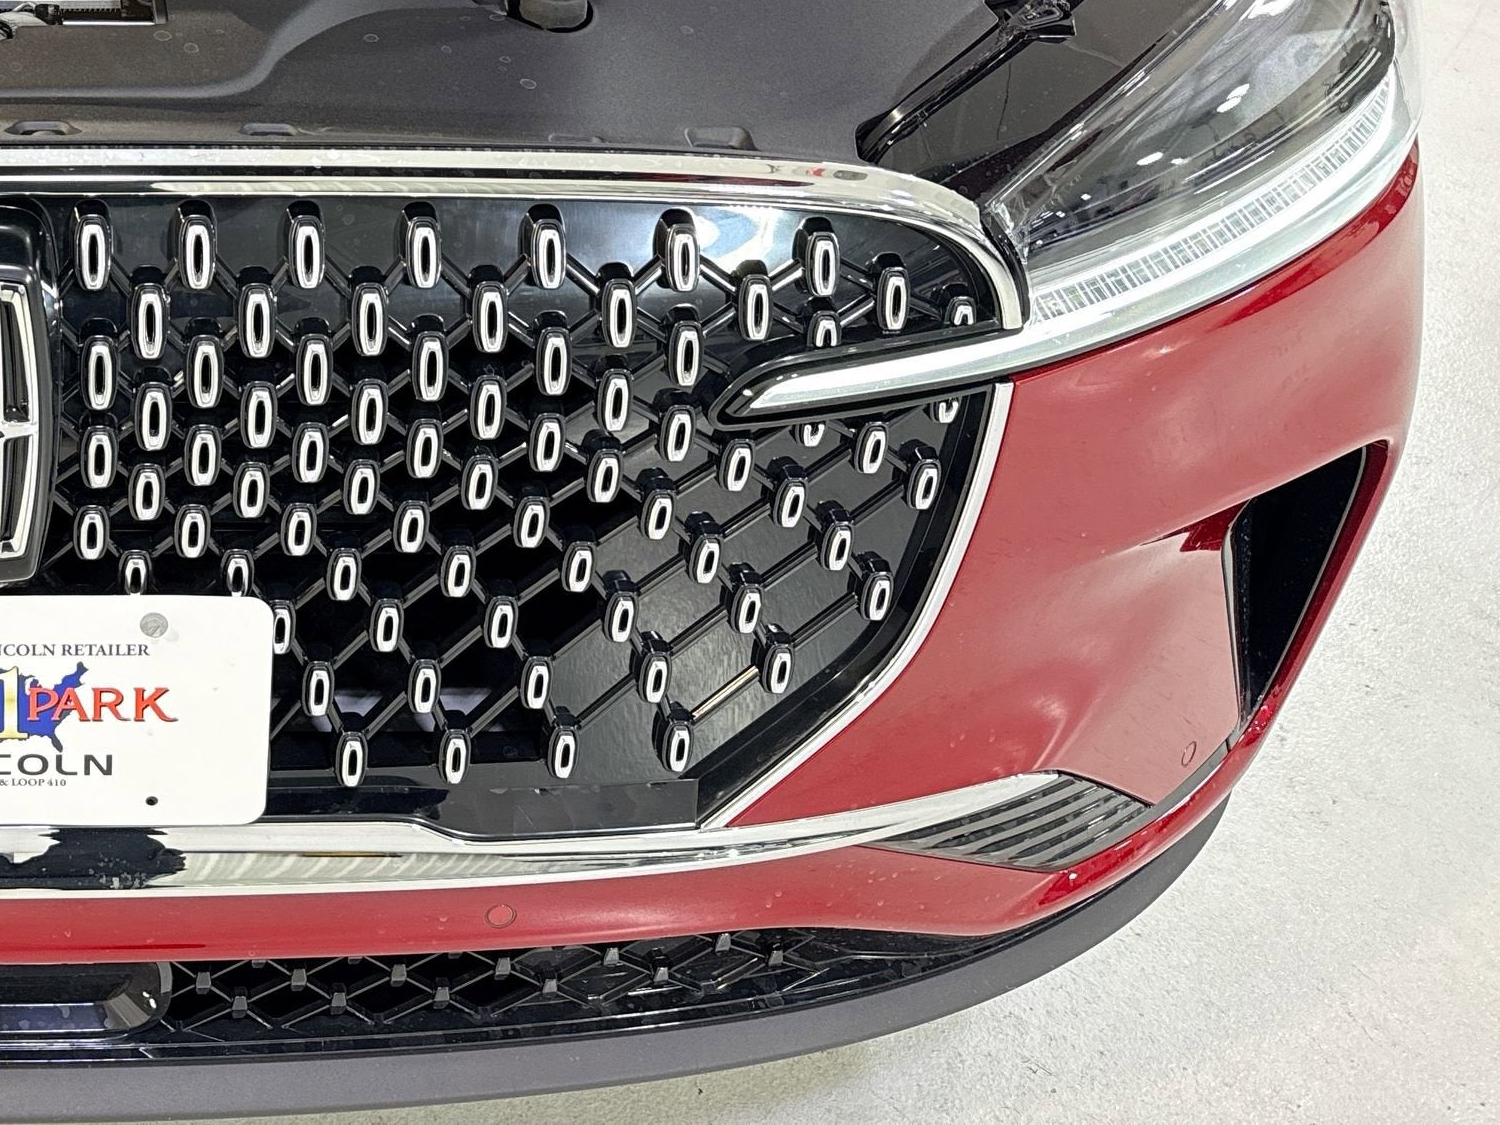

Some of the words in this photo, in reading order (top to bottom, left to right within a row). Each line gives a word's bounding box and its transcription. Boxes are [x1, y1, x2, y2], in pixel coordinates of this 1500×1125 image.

[60, 643, 150, 657] RETAILER
[27, 686, 179, 724] PARK
[0, 777, 9, 787] &
[11, 777, 45, 787] LOOP
[46, 777, 67, 787] 410
